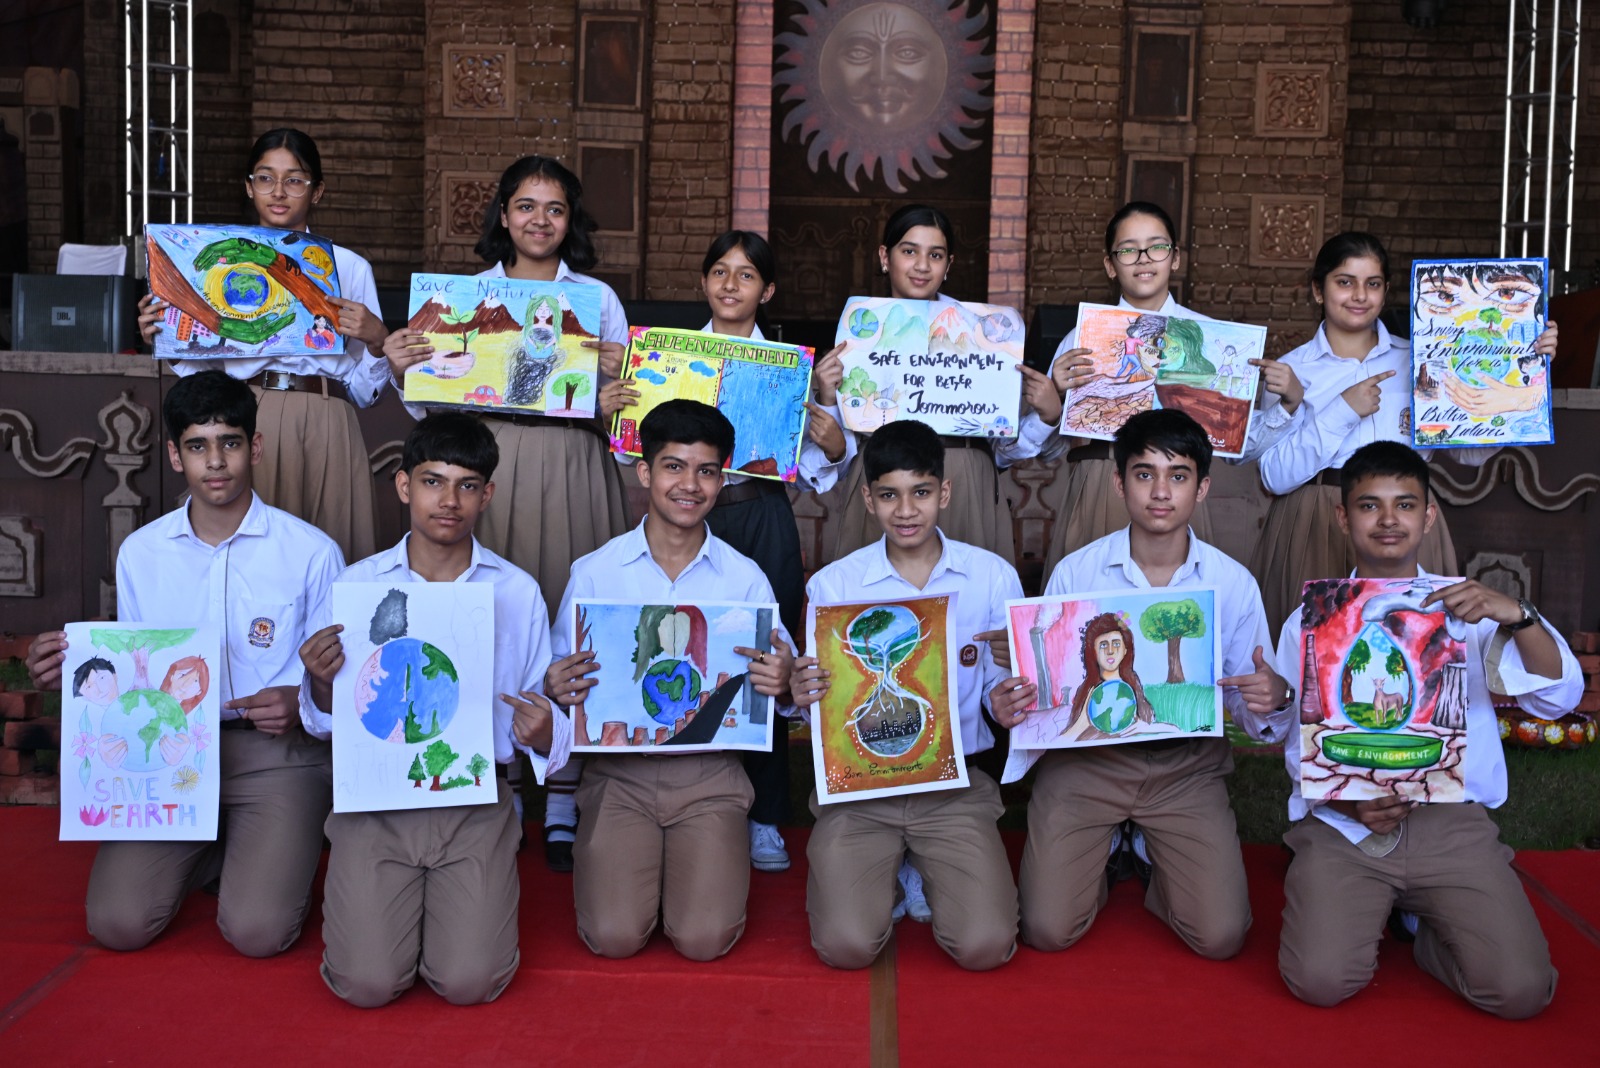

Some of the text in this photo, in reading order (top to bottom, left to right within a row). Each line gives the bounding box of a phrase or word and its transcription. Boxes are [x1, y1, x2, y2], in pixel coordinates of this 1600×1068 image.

[412, 275, 538, 300] Save Nature
[56, 311, 71, 321] JBL
[1413, 318, 1465, 343] Saving
[685, 337, 799, 366] ENVIRONMENT
[868, 350, 1004, 371] SAFE ENVIRONMENT
[1454, 355, 1501, 373] for a
[903, 373, 973, 391] FOR BETTER
[1330, 745, 1430, 760] SAVE ENVIRONMENT
[93, 776, 160, 803] SAVE
[110, 802, 197, 828] EARTH
